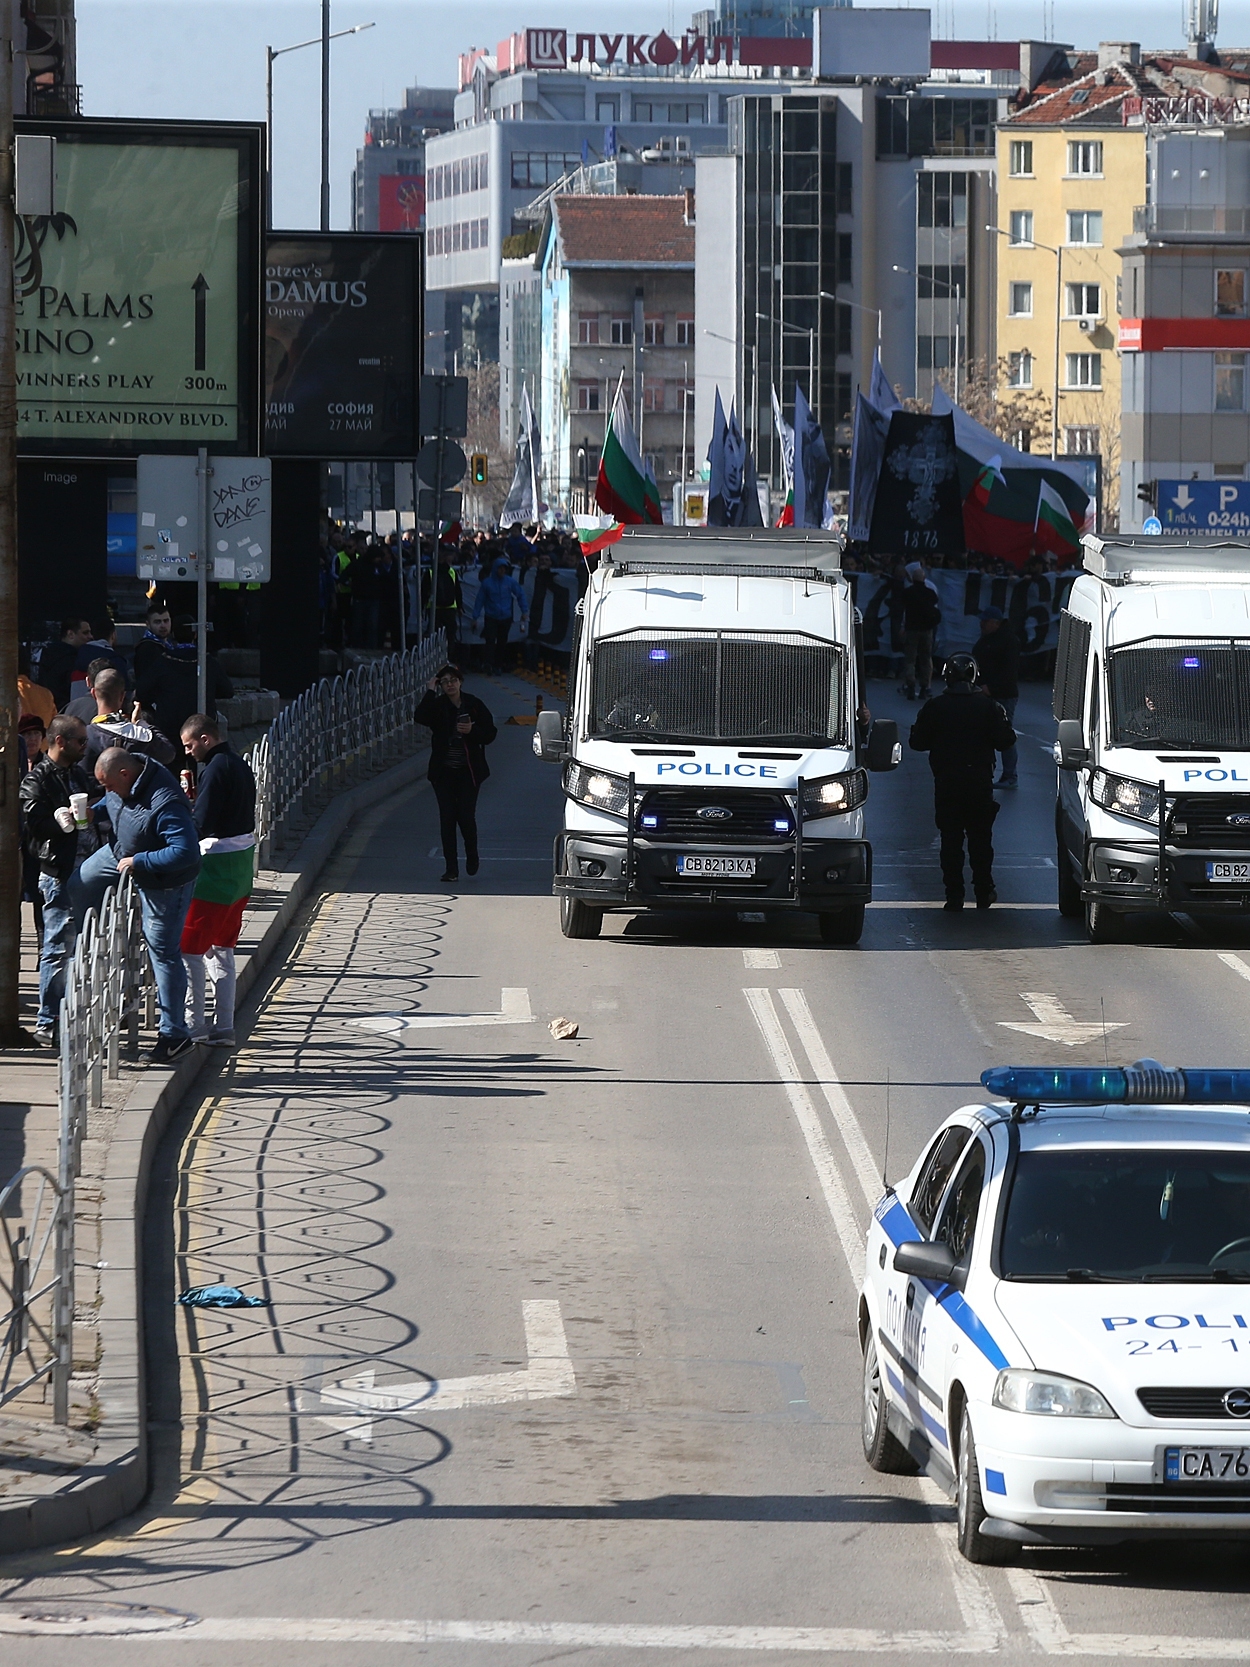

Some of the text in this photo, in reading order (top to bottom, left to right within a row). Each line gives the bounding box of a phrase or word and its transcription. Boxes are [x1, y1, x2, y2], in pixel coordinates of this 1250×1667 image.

[265, 263, 322, 278] otzev's
[37, 286, 154, 320] PALMS
[268, 305, 305, 319] Opera
[108, 374, 155, 390] PLAY
[184, 376, 228, 391] 300m
[265, 401, 374, 416] ДИВ СОФИЯ
[35, 410, 49, 424] T.
[53, 410, 175, 426] ALEXANDROV
[179, 412, 228, 427] BLVD.
[329, 419, 342, 431] 27
[345, 416, 372, 431] МАЙ
[43, 470, 77, 486] Image
[1220, 485, 1239, 511] P
[657, 762, 778, 779] POLICE
[704, 858, 735, 872] 8213
